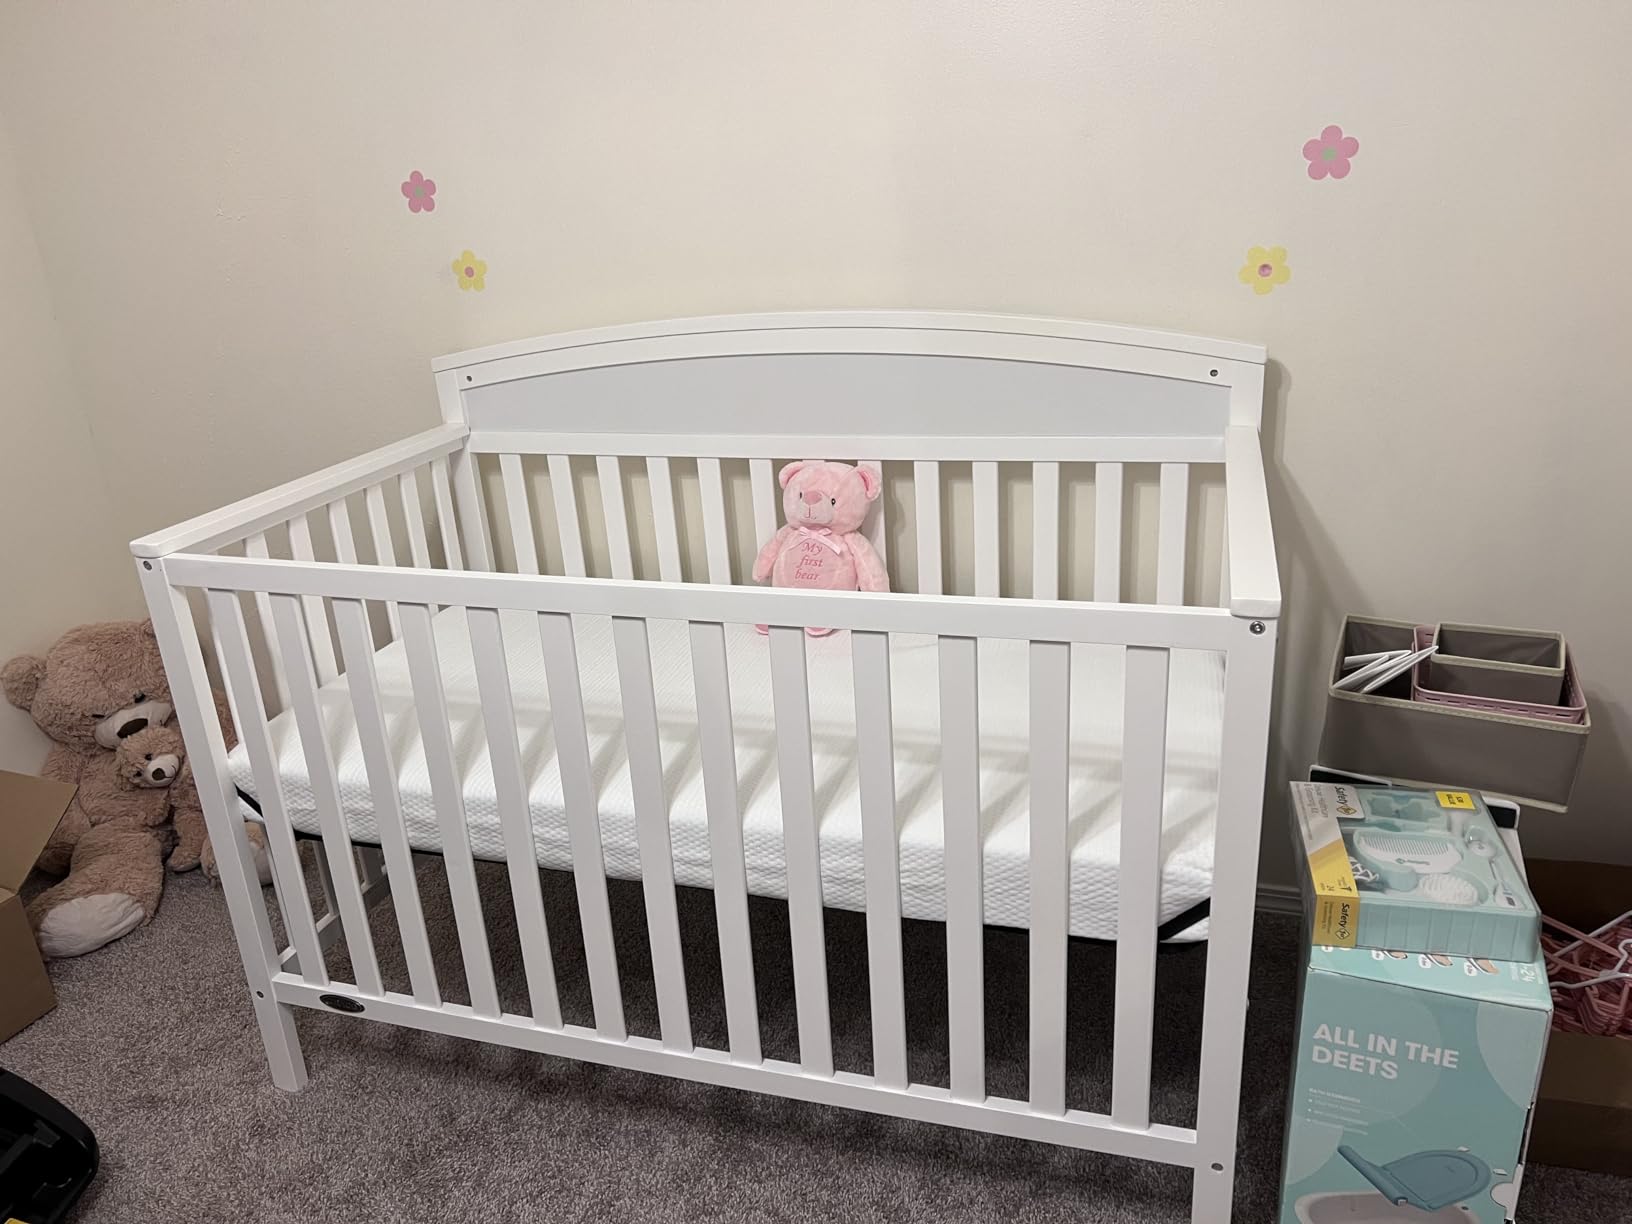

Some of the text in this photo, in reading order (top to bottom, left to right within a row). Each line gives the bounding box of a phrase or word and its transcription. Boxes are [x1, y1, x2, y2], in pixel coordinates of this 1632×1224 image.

[801, 542, 823, 556] My
[796, 554, 823, 569] first
[794, 567, 820, 581] bear
[1334, 786, 1349, 806] Safety
[1338, 902, 1350, 929] Safety
[1312, 1023, 1460, 1069] ALL IN THE
[1311, 1045, 1399, 1080] DEETS
